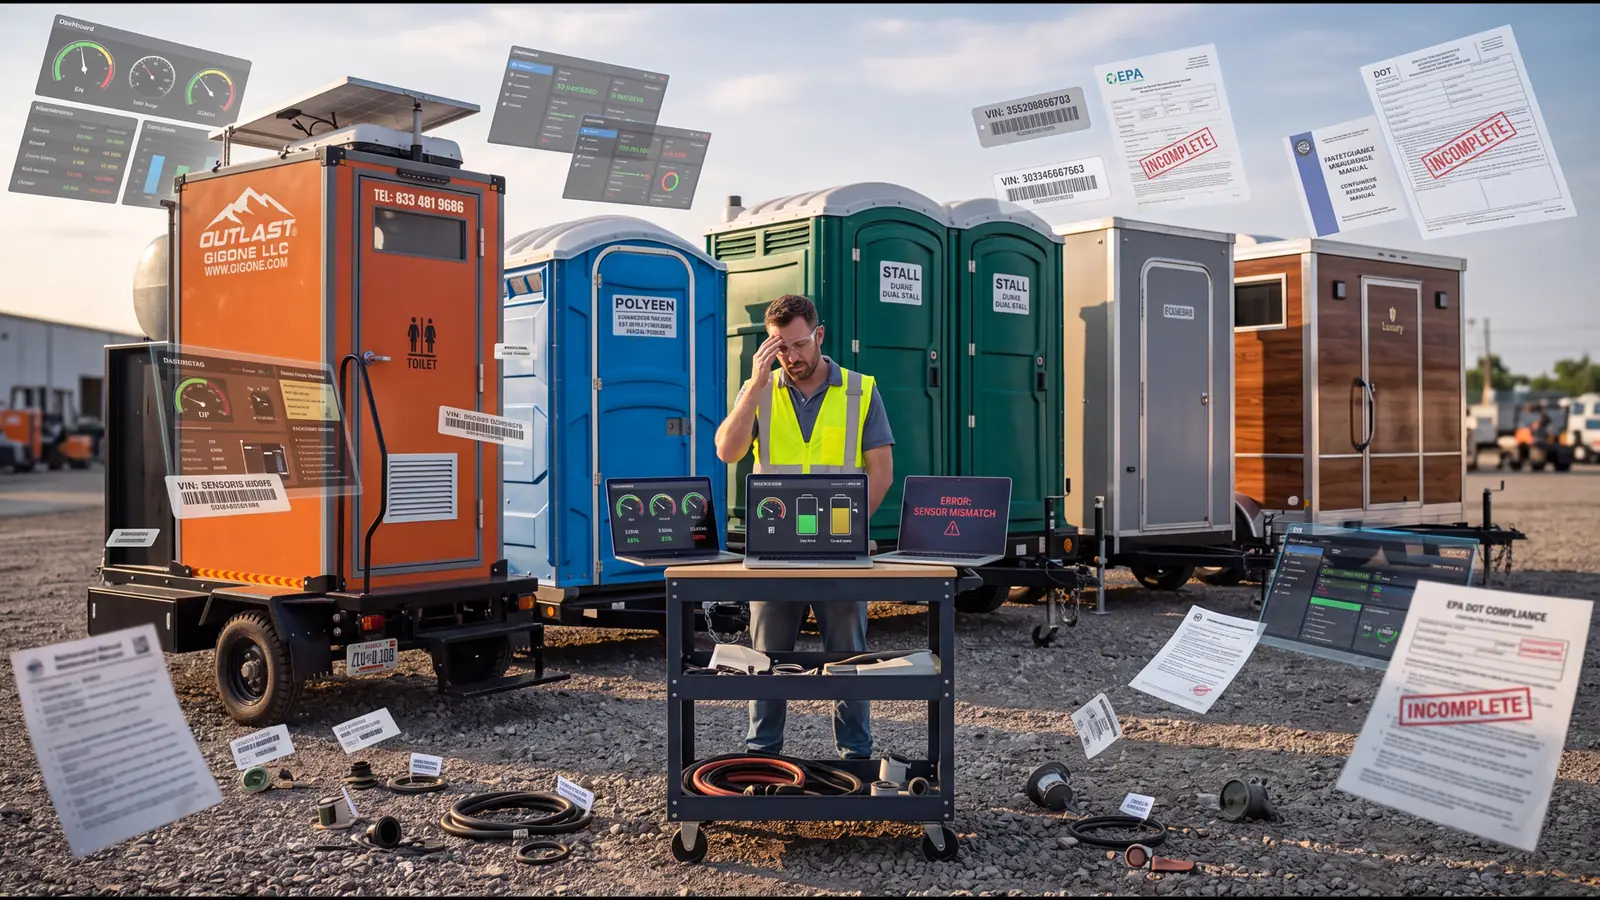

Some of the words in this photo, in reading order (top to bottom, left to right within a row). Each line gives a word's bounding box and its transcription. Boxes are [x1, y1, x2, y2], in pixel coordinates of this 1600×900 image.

[1117, 68, 1144, 82] EPA
[1373, 67, 1392, 79] DOT
[985, 107, 1005, 119] VIN:
[1428, 119, 1509, 172] INCOMPLETE
[1144, 133, 1212, 174] INCOMPLETE
[1338, 164, 1369, 176] MANUAL
[1000, 175, 1021, 187] VIN:
[374, 188, 394, 203] TEL:
[395, 192, 415, 206] 833
[417, 195, 435, 209] 481
[438, 198, 464, 214] 9686
[199, 218, 296, 249] OUTLAST
[204, 246, 257, 264] GIGONE
[262, 242, 289, 257] LLC
[204, 257, 288, 277] WWW.GIGONE.COM
[883, 265, 920, 282] STALL
[996, 277, 1028, 293] STALL
[882, 290, 901, 299] DUAL
[901, 292, 920, 301] STALL
[615, 297, 675, 312] POLYEEN
[995, 301, 1011, 309] DUAL
[1012, 303, 1028, 311] STALL
[406, 357, 438, 370] TOILET
[177, 481, 199, 491] VIN:
[940, 496, 972, 506] ERROR:
[913, 507, 948, 517] SENSOR
[949, 508, 996, 518] MISMATCH
[1446, 600, 1464, 611] EPA
[1465, 602, 1484, 614] DOT
[1486, 606, 1548, 622] COMPLIANCE
[1407, 696, 1523, 718] INCOMPLETE
